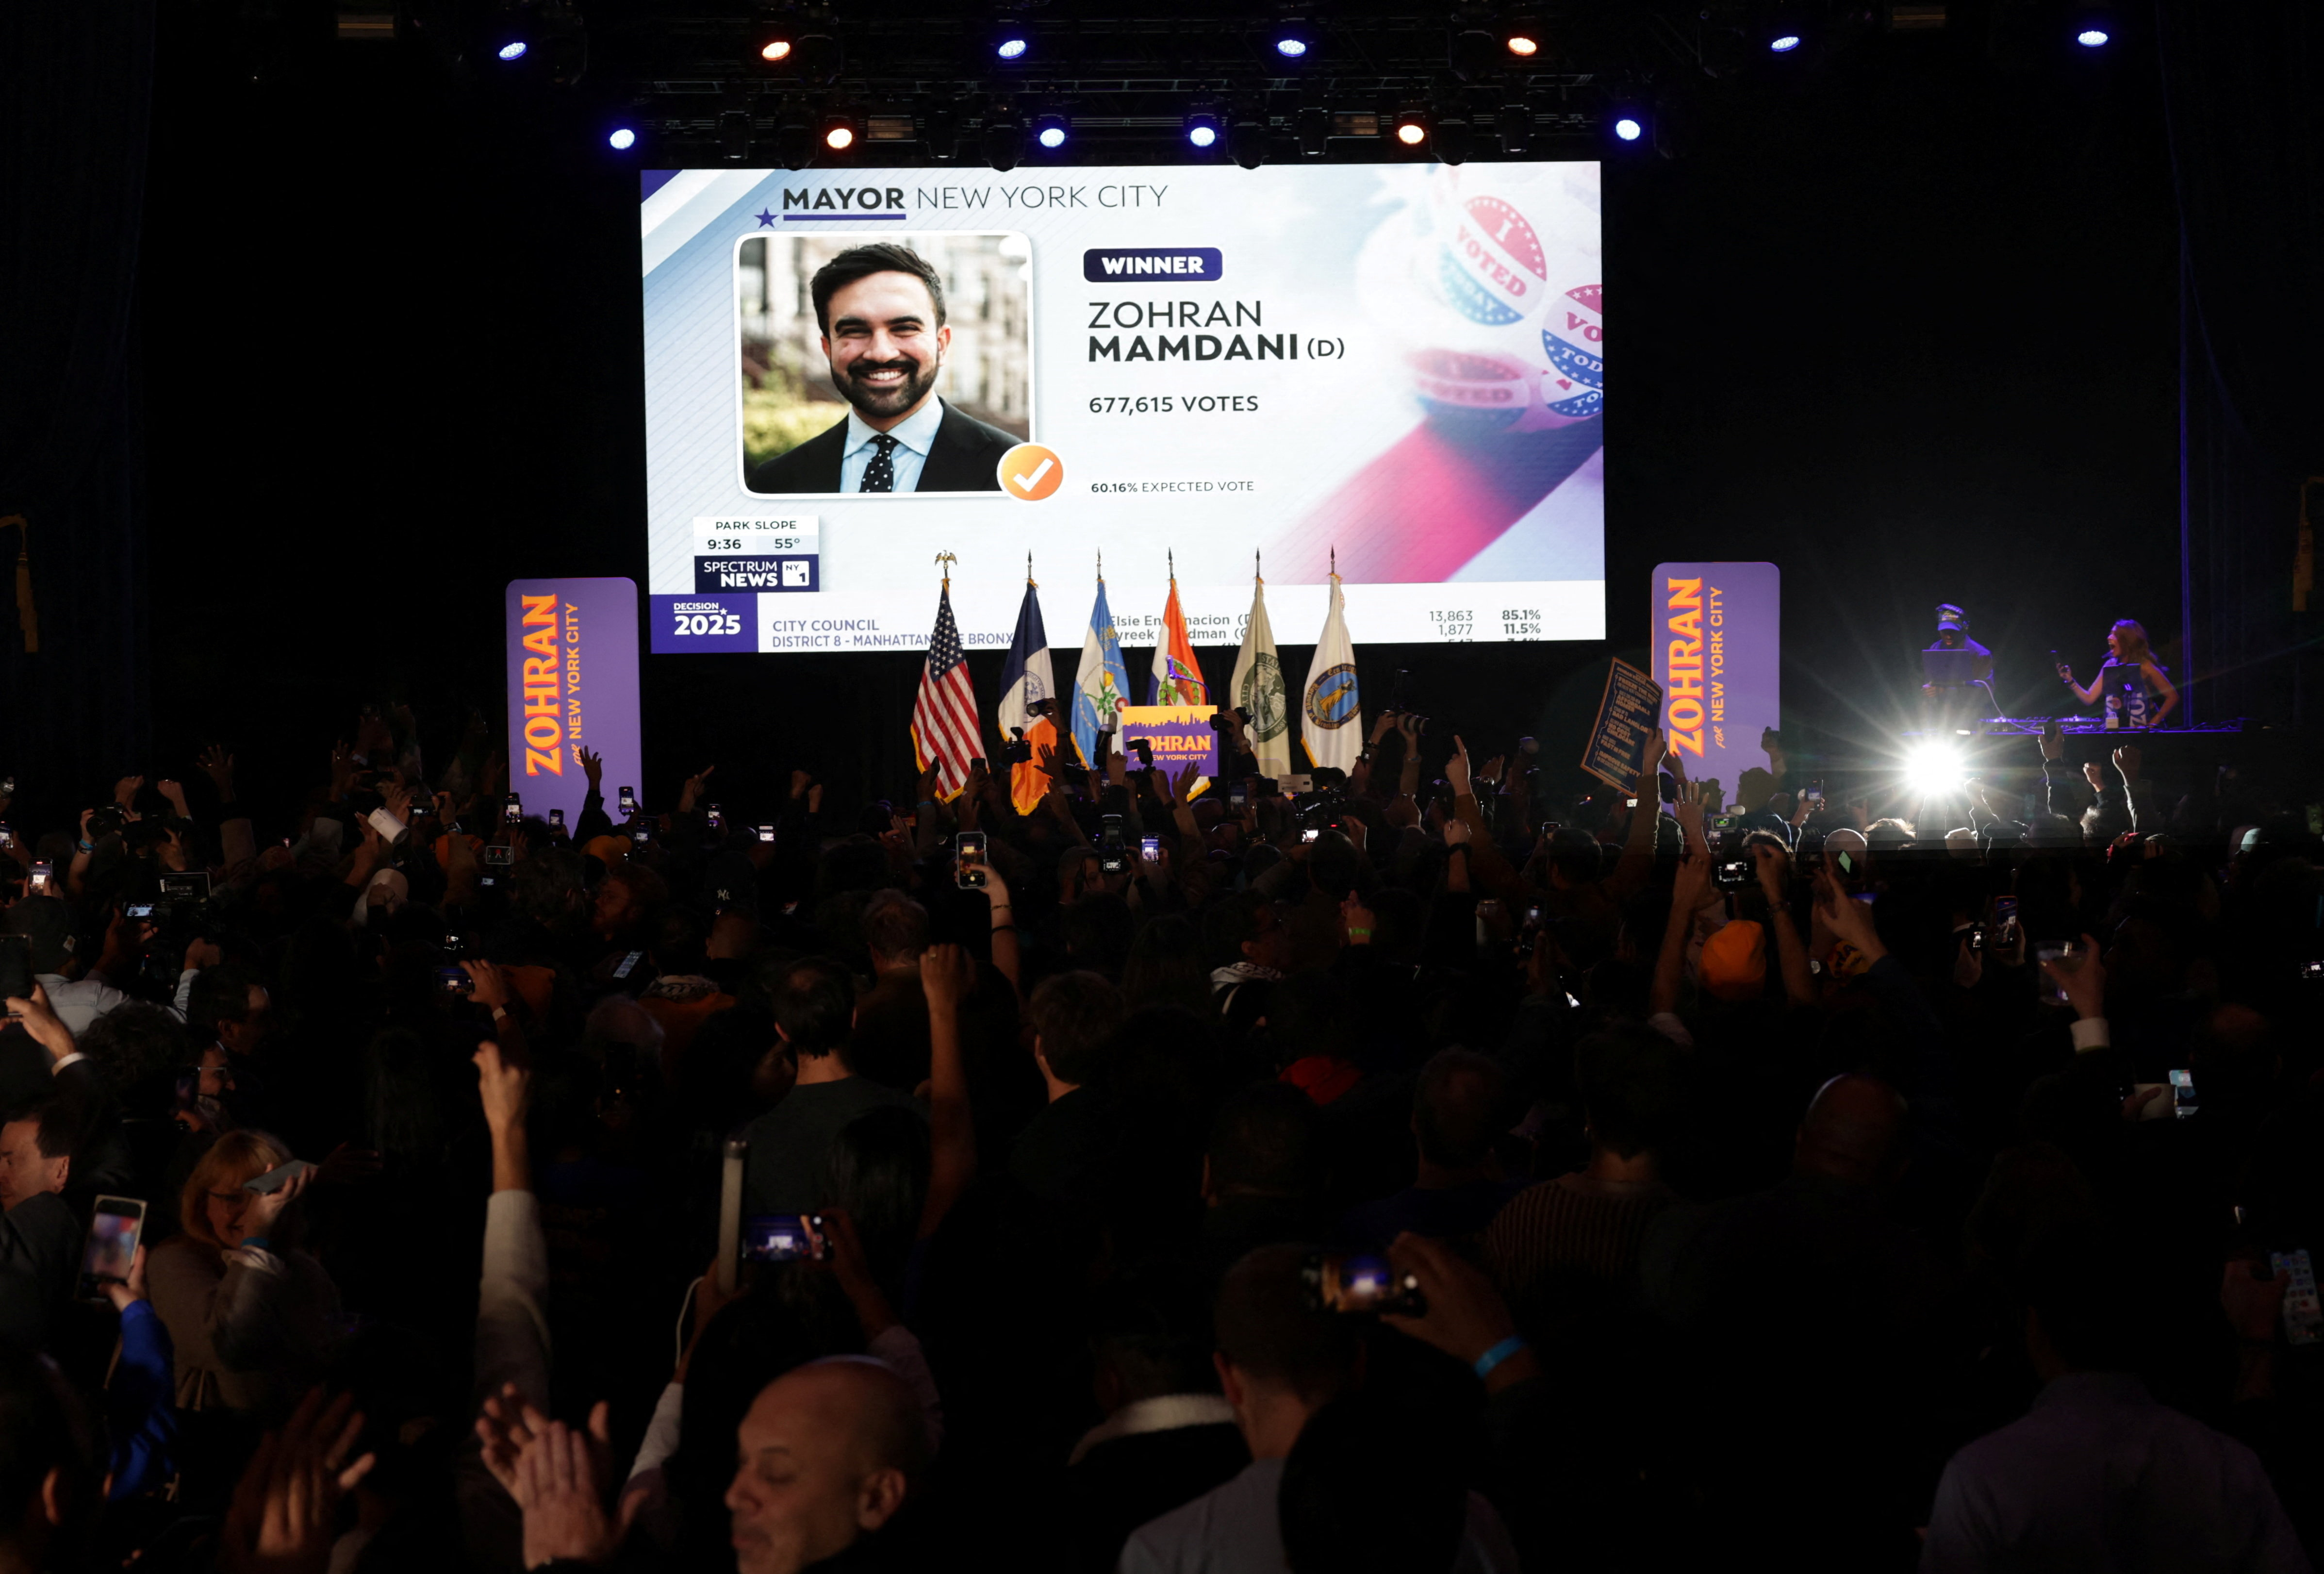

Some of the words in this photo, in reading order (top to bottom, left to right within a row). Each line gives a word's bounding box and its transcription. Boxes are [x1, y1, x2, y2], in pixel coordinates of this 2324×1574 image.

[783, 187, 906, 210] MAYOR
[918, 187, 991, 209] NEW
[1001, 186, 1088, 208] YORK
[1098, 185, 1168, 207] CITY
[1101, 256, 1204, 275] WINNER
[1457, 224, 1527, 297] VOTED
[1088, 300, 1262, 329] ZOHRAN
[1088, 333, 1298, 362] MAMDANI
[1307, 337, 1345, 360] (D)
[1089, 397, 1173, 416] 677,615
[1182, 396, 1259, 412] VOTES
[1091, 483, 1138, 493] 60.16%
[1142, 481, 1213, 492] EXPECTED
[1218, 481, 1254, 491] VOTE
[715, 521, 750, 530] PARK
[755, 520, 797, 530] SLOPE
[708, 539, 742, 549] 9:36
[775, 538, 800, 548] 55°
[704, 561, 777, 572] SPECTRUM
[721, 573, 778, 587] NEWS
[799, 572, 806, 582] 1
[674, 602, 719, 611] DECISION
[1430, 610, 1473, 623] 13,863
[1502, 609, 1541, 620] 85.1%
[1710, 586, 1723, 627] CITY
[565, 602, 578, 643] CITY
[674, 614, 741, 635] 2025
[773, 621, 807, 632] CITY
[811, 619, 880, 631] COUNCIL
[1438, 624, 1473, 637] 1,877
[1504, 623, 1541, 634] 11.5%
[773, 635, 830, 647] DISTRICT
[833, 635, 841, 646] 8
[853, 633, 933, 646] MANHATTAN
[969, 632, 1014, 645] BRONX
[1710, 630, 1724, 675] YORK
[567, 647, 581, 695] YORK
[1667, 577, 1705, 759] ZOHRAN
[521, 593, 562, 777] ZOHRAN
[1711, 681, 1724, 722] NEW
[568, 698, 582, 739] NEW
[1713, 726, 1726, 749] FOR
[571, 744, 584, 767] FOR
